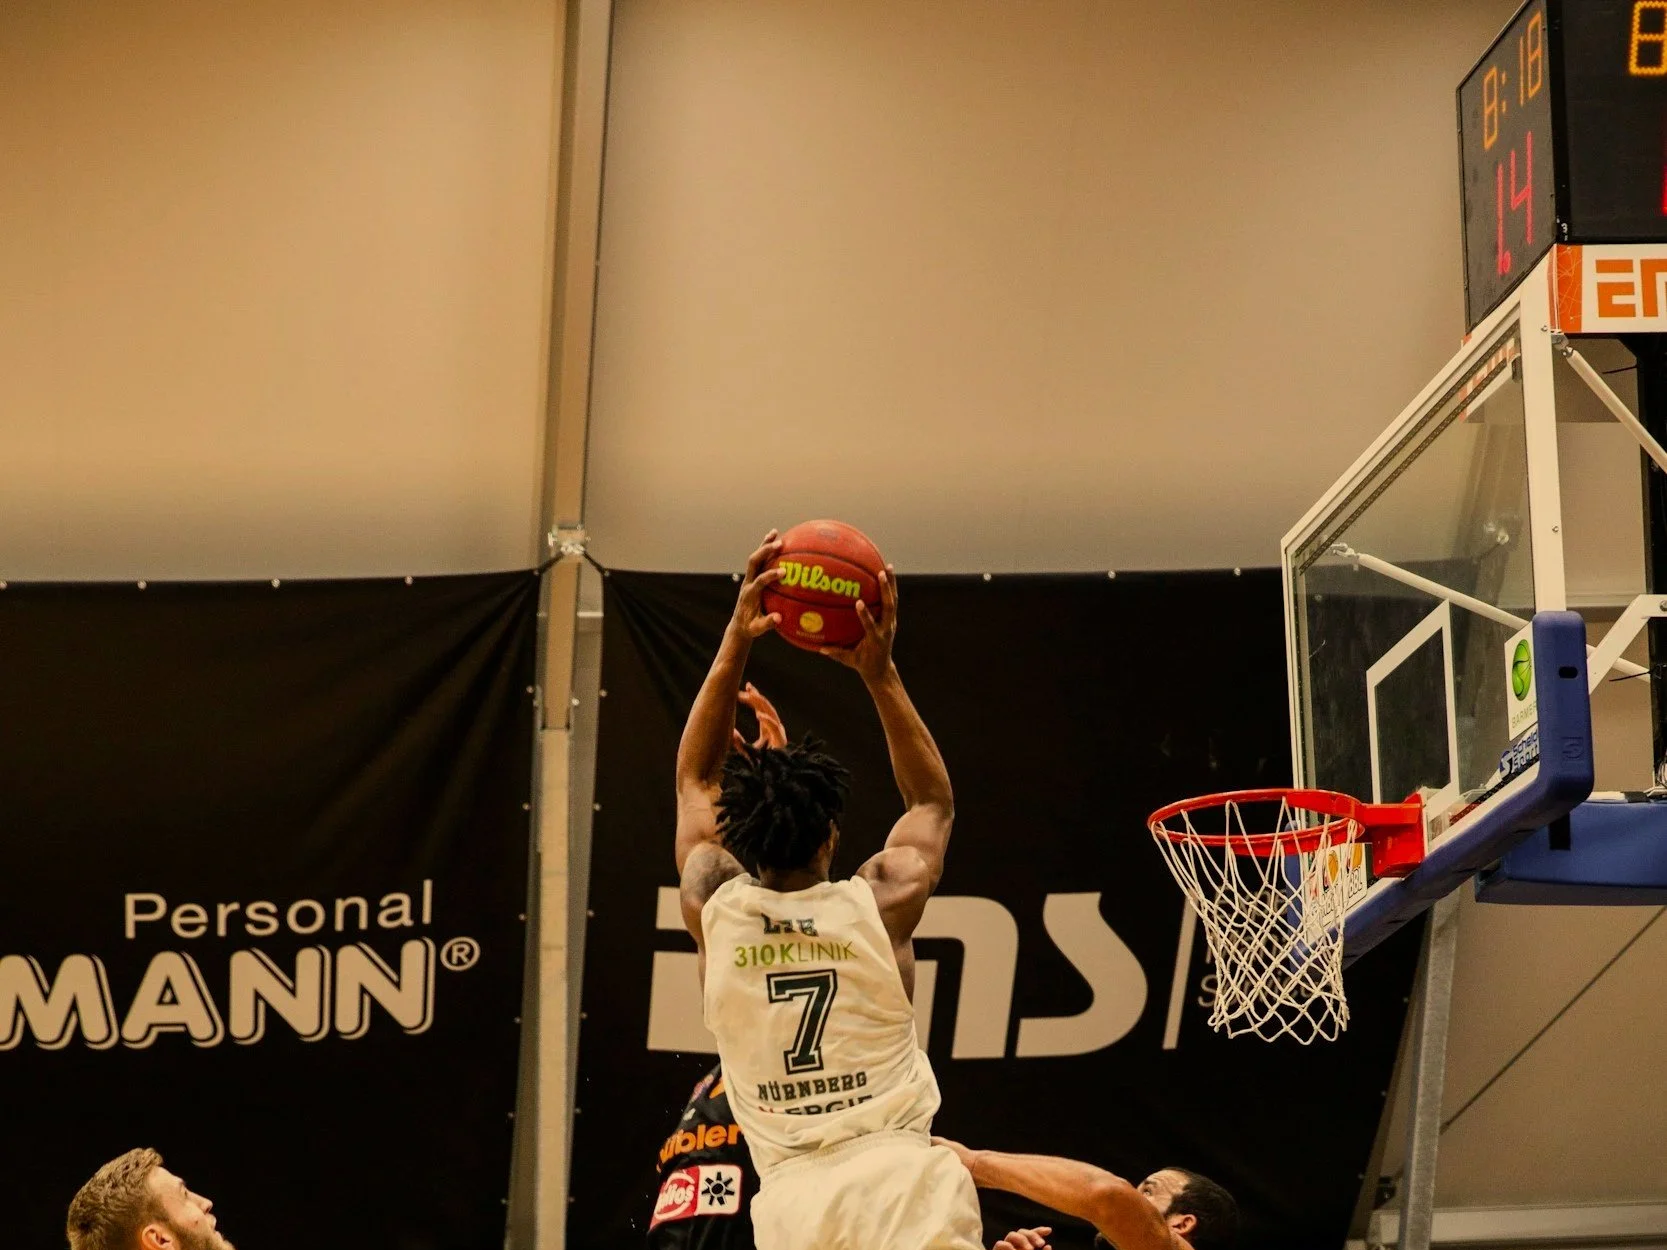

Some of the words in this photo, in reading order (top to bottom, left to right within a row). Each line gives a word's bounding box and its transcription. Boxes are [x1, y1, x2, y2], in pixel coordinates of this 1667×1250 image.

[778, 561, 861, 598] Wilson
[125, 879, 433, 940] Personal
[765, 968, 838, 1075] 7
[757, 1071, 867, 1102] NÜRNBERG
